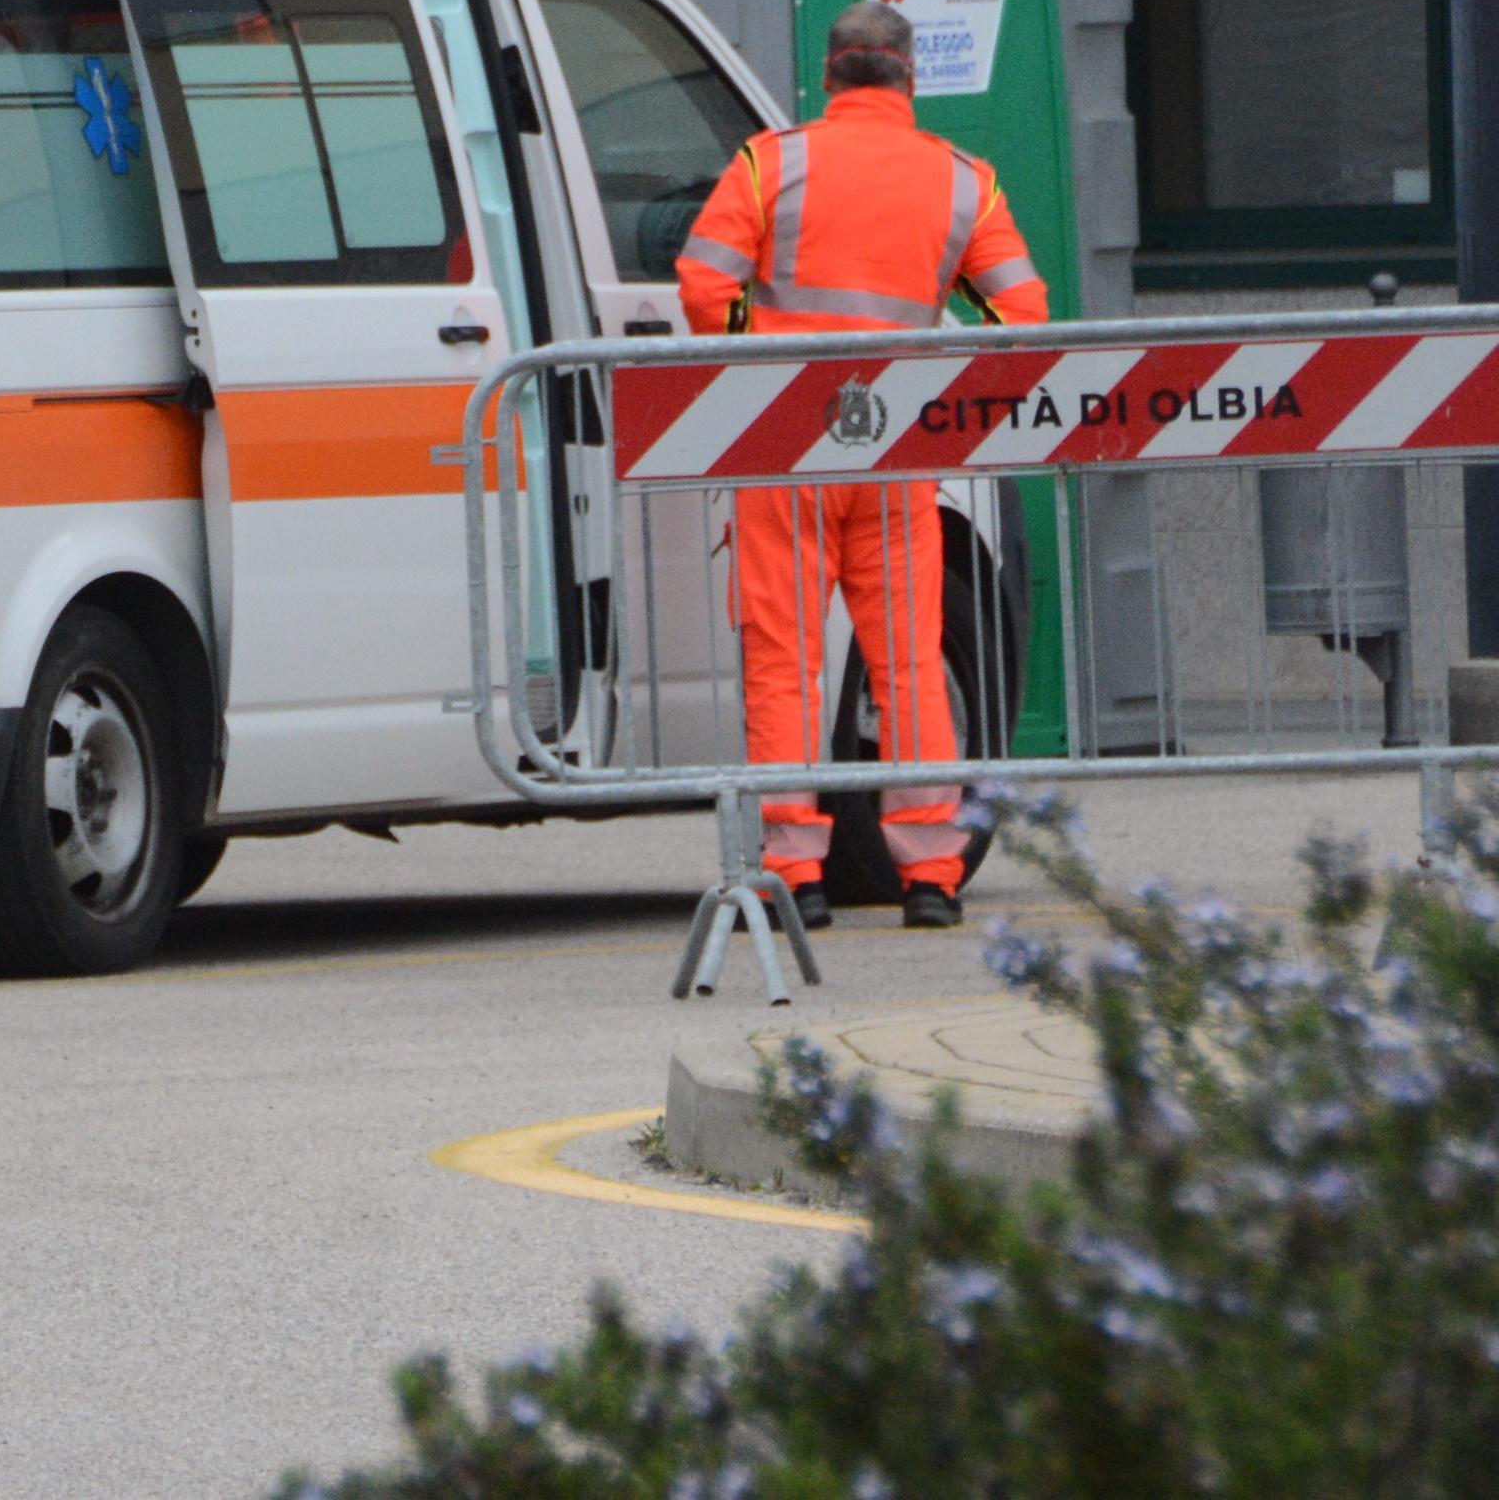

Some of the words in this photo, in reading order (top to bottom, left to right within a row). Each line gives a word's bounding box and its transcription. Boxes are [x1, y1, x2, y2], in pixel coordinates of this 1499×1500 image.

[919, 386, 1063, 434] CITTÀ
[1079, 392, 1128, 427] DI
[1148, 384, 1304, 424] OLBIA
